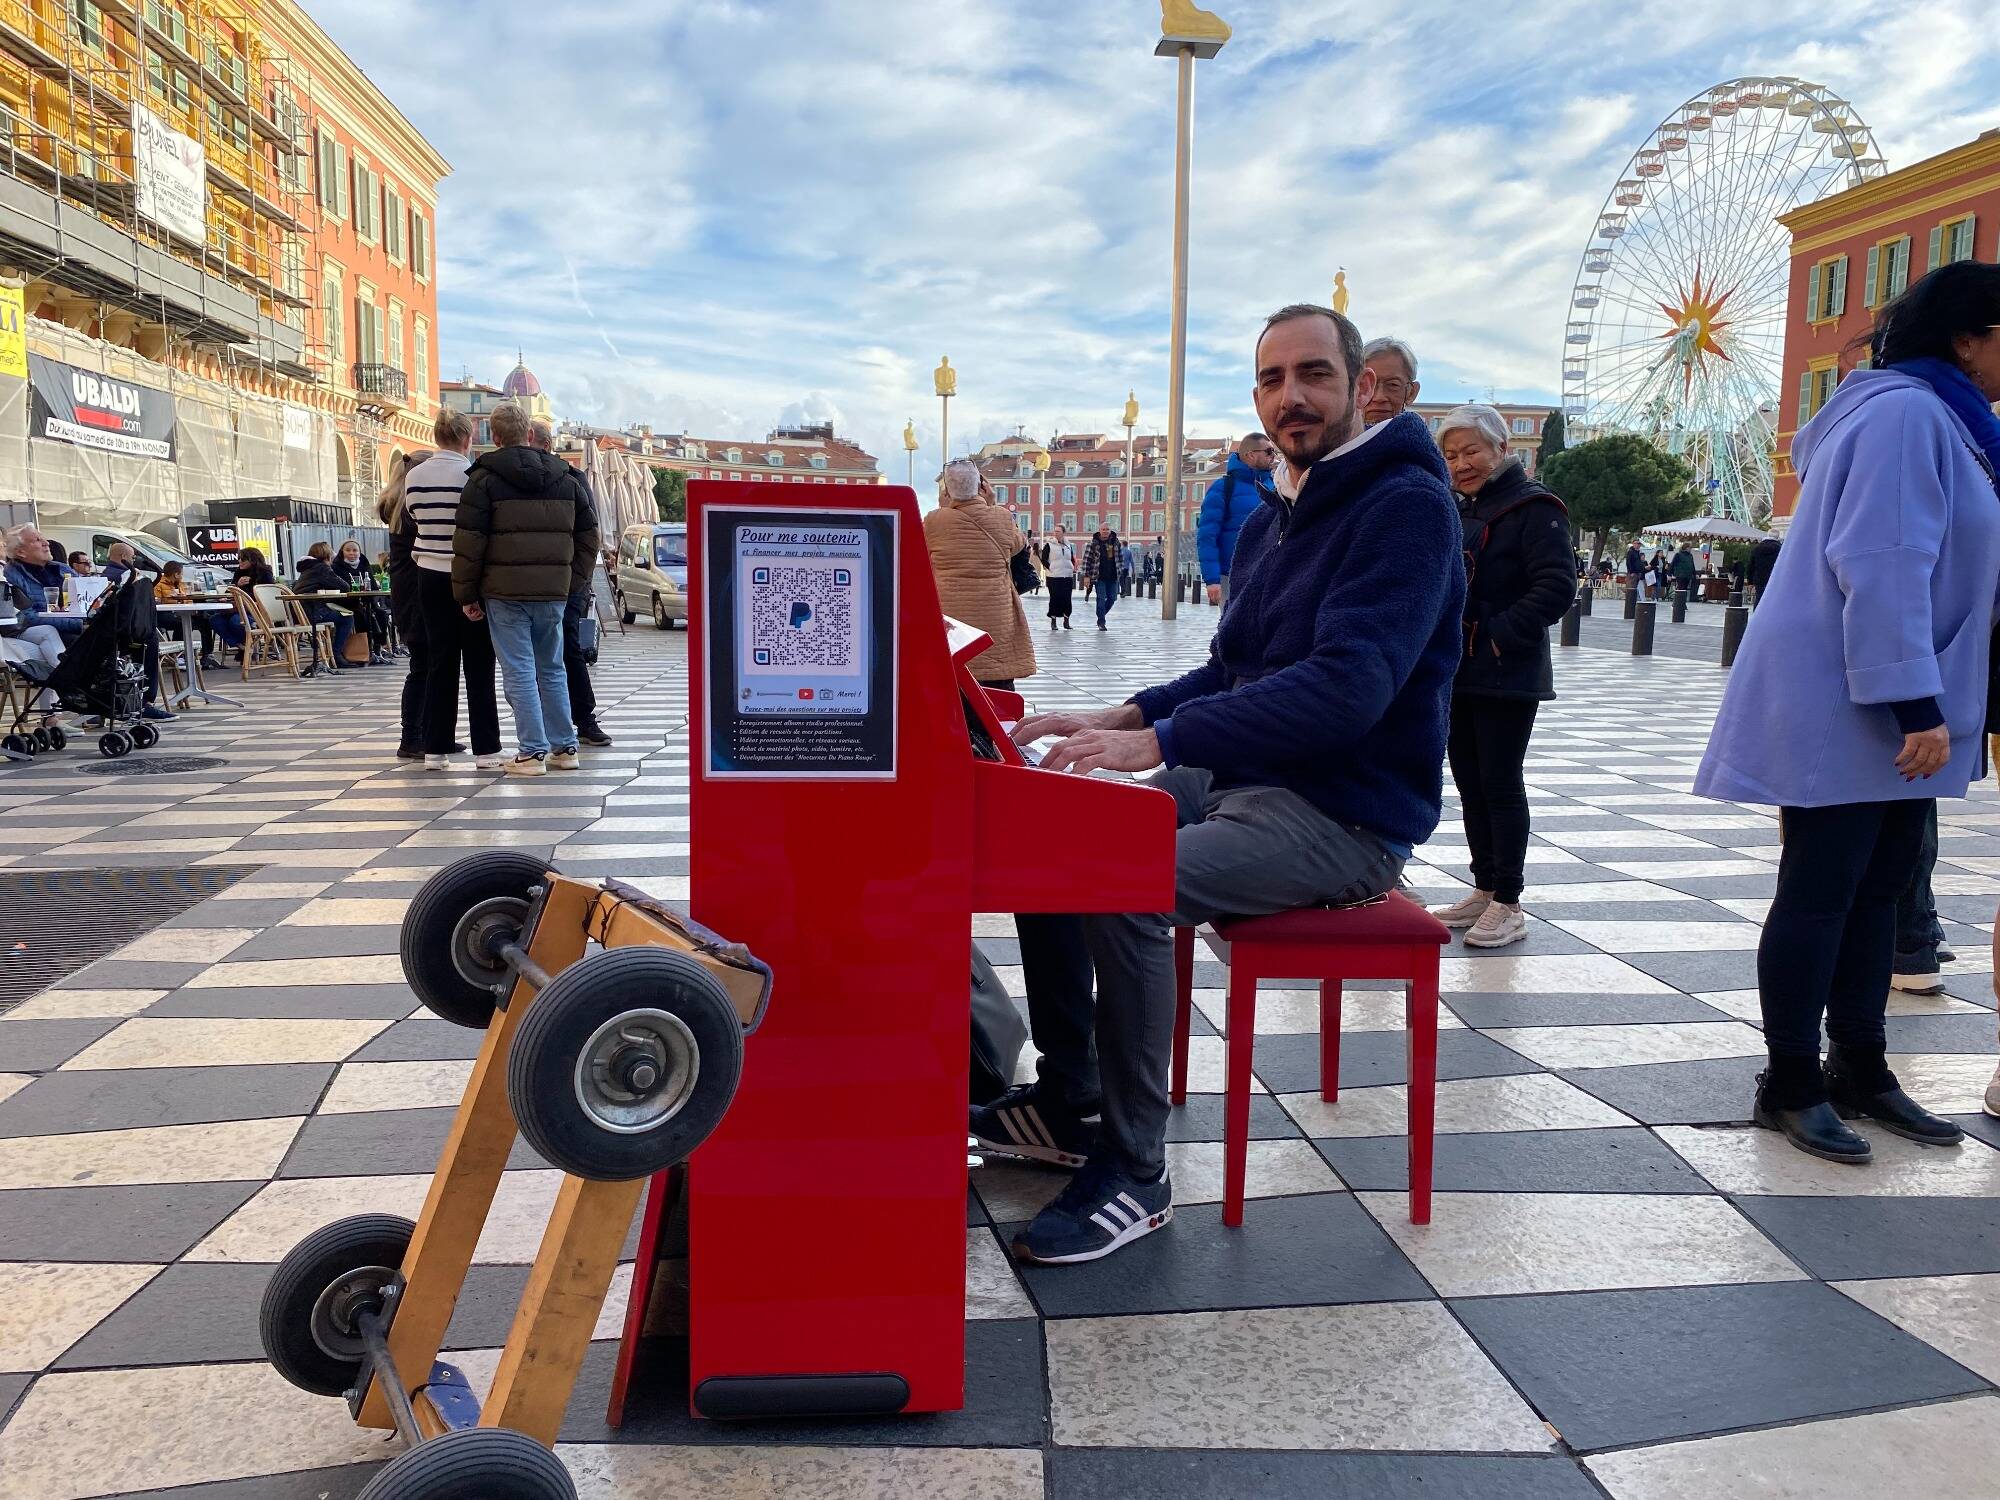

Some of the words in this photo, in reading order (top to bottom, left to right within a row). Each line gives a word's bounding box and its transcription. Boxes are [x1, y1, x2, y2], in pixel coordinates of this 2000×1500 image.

[72, 372, 141, 417] UBALDI
[121, 419, 141, 433] .com
[209, 528, 238, 542] UB
[741, 528, 774, 542] Pour
[777, 532, 798, 543] me
[802, 531, 861, 546] soutenir,
[836, 690, 857, 698] Merci
